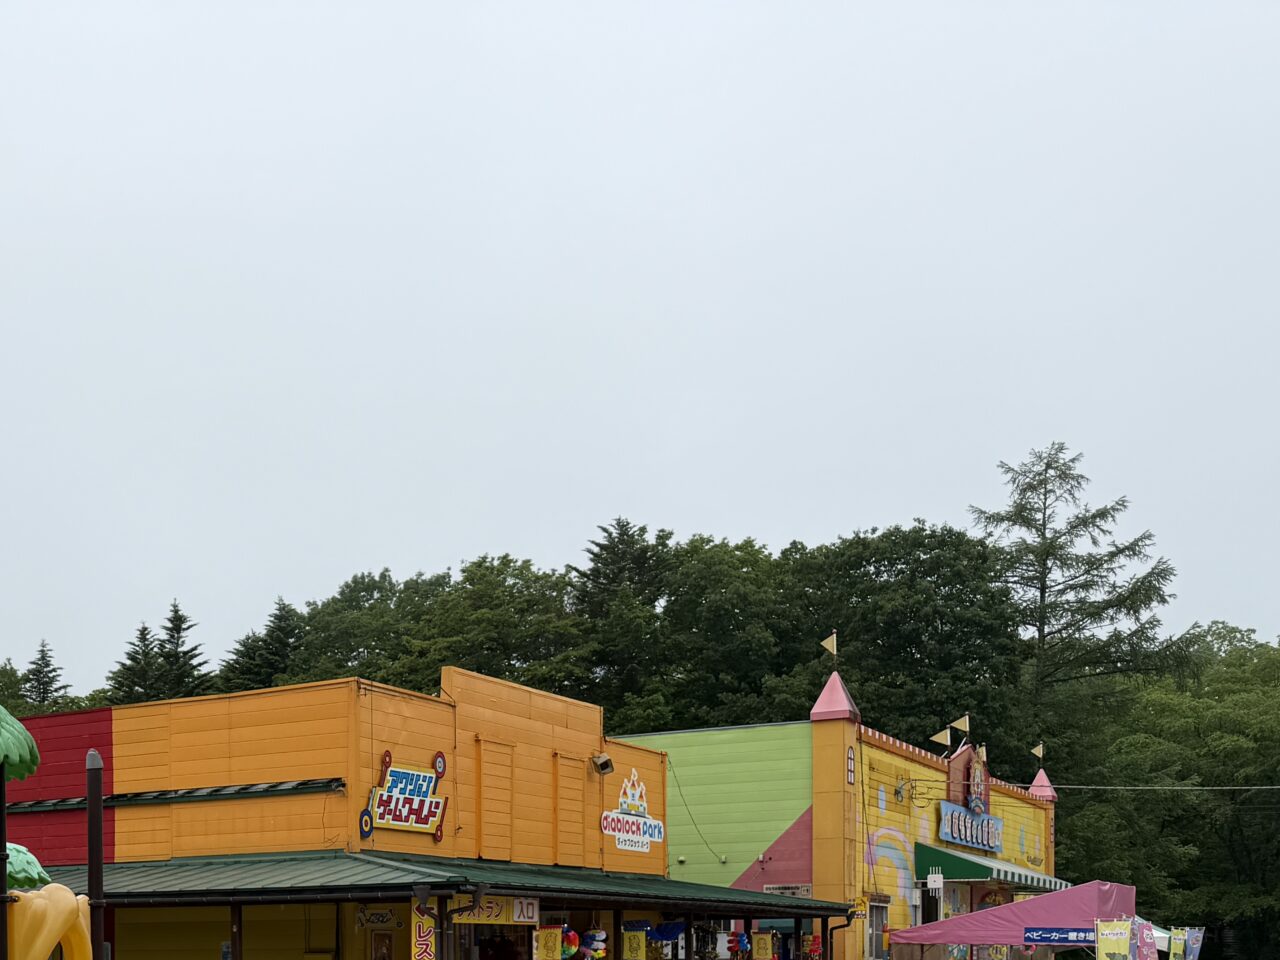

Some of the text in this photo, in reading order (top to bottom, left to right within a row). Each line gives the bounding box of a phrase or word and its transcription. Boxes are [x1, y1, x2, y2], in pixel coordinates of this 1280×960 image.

[603, 814, 663, 839] diablock park
[518, 901, 535, 919] 入口
[1024, 932, 1095, 941] ベビーカー置き場
